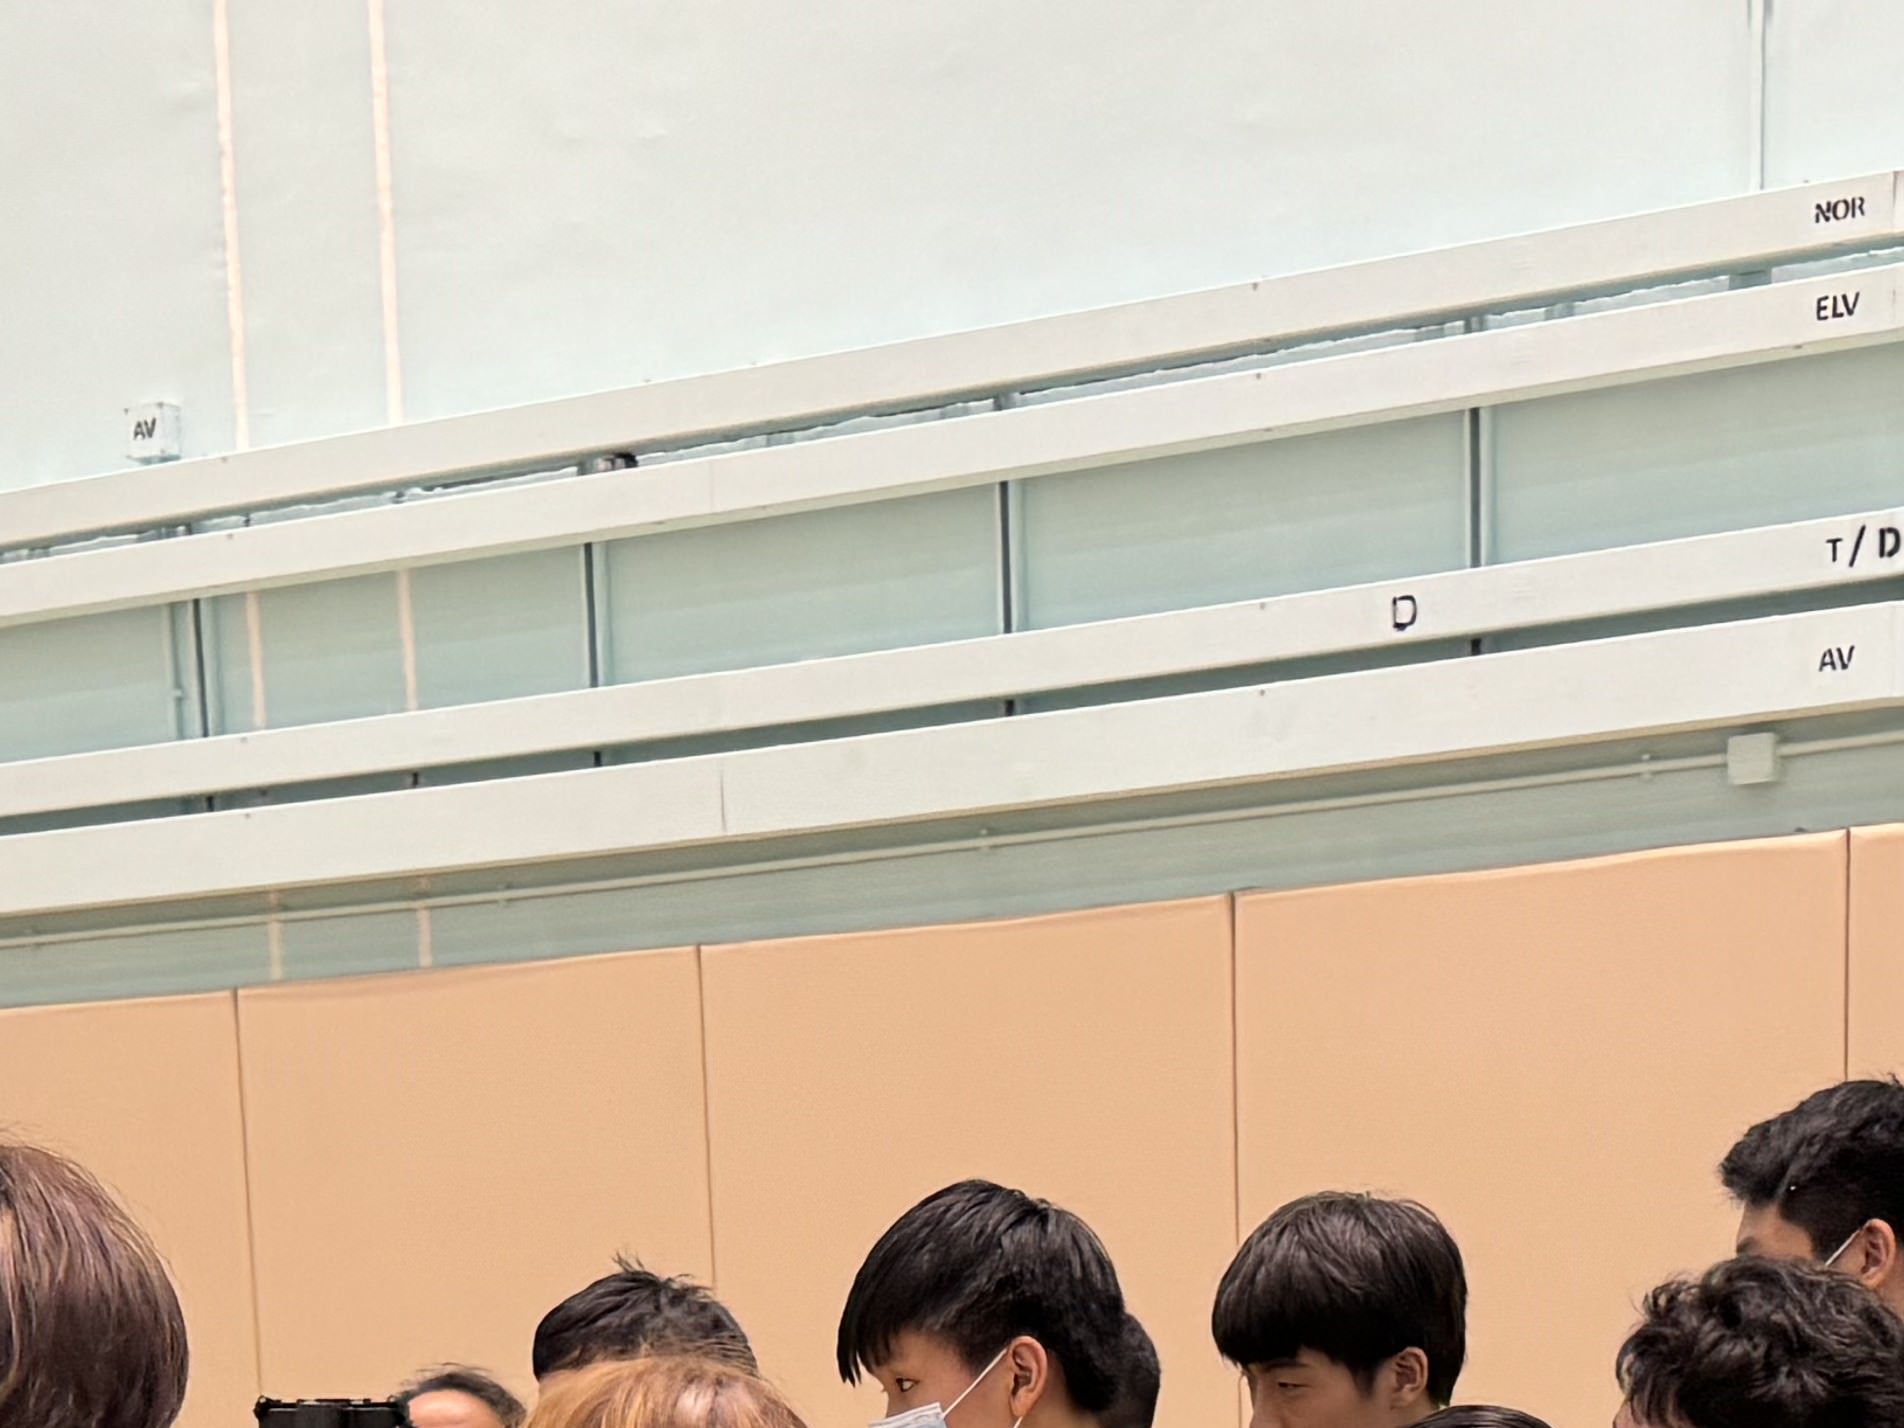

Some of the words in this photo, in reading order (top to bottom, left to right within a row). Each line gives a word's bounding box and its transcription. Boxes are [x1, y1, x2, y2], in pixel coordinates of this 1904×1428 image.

[1815, 196, 1865, 224] NOR
[1816, 291, 1860, 321] ELV
[133, 416, 157, 441] AV
[1818, 645, 1855, 672] AV
